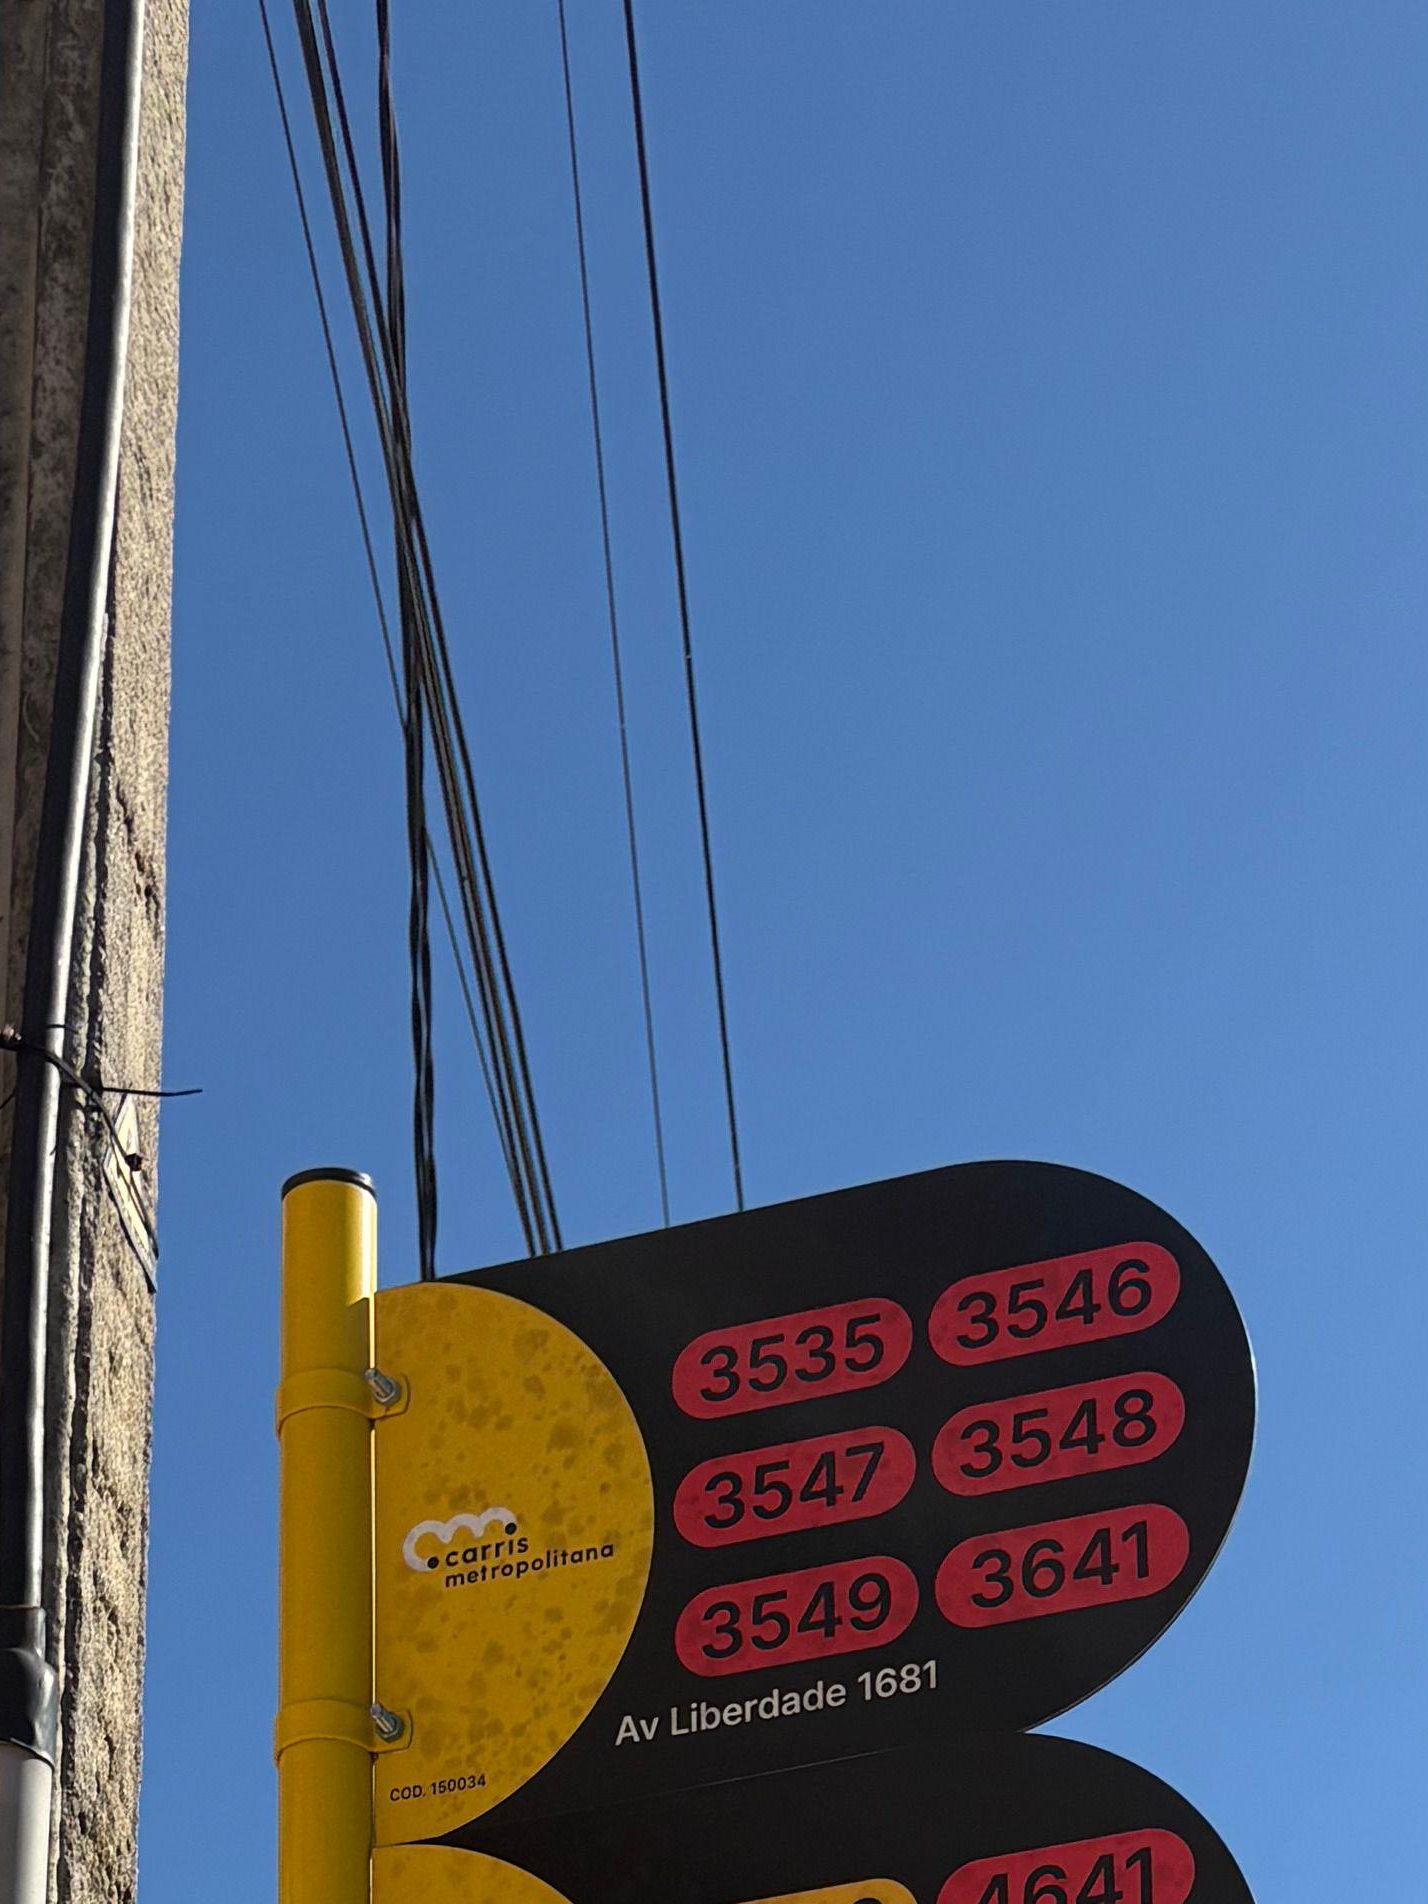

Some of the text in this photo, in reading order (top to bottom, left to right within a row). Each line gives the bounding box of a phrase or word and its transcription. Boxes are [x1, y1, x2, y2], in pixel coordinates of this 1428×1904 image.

[700, 1259, 1153, 1403] 3535 3546
[703, 1390, 1157, 1530] 3547 3548
[444, 1525, 530, 1567] carris
[445, 1542, 615, 1588] metropolitana
[703, 1521, 1154, 1659] 3549 3641
[615, 1660, 939, 1746] Av Liberdade 1681
[431, 1775, 488, 1797] 150034
